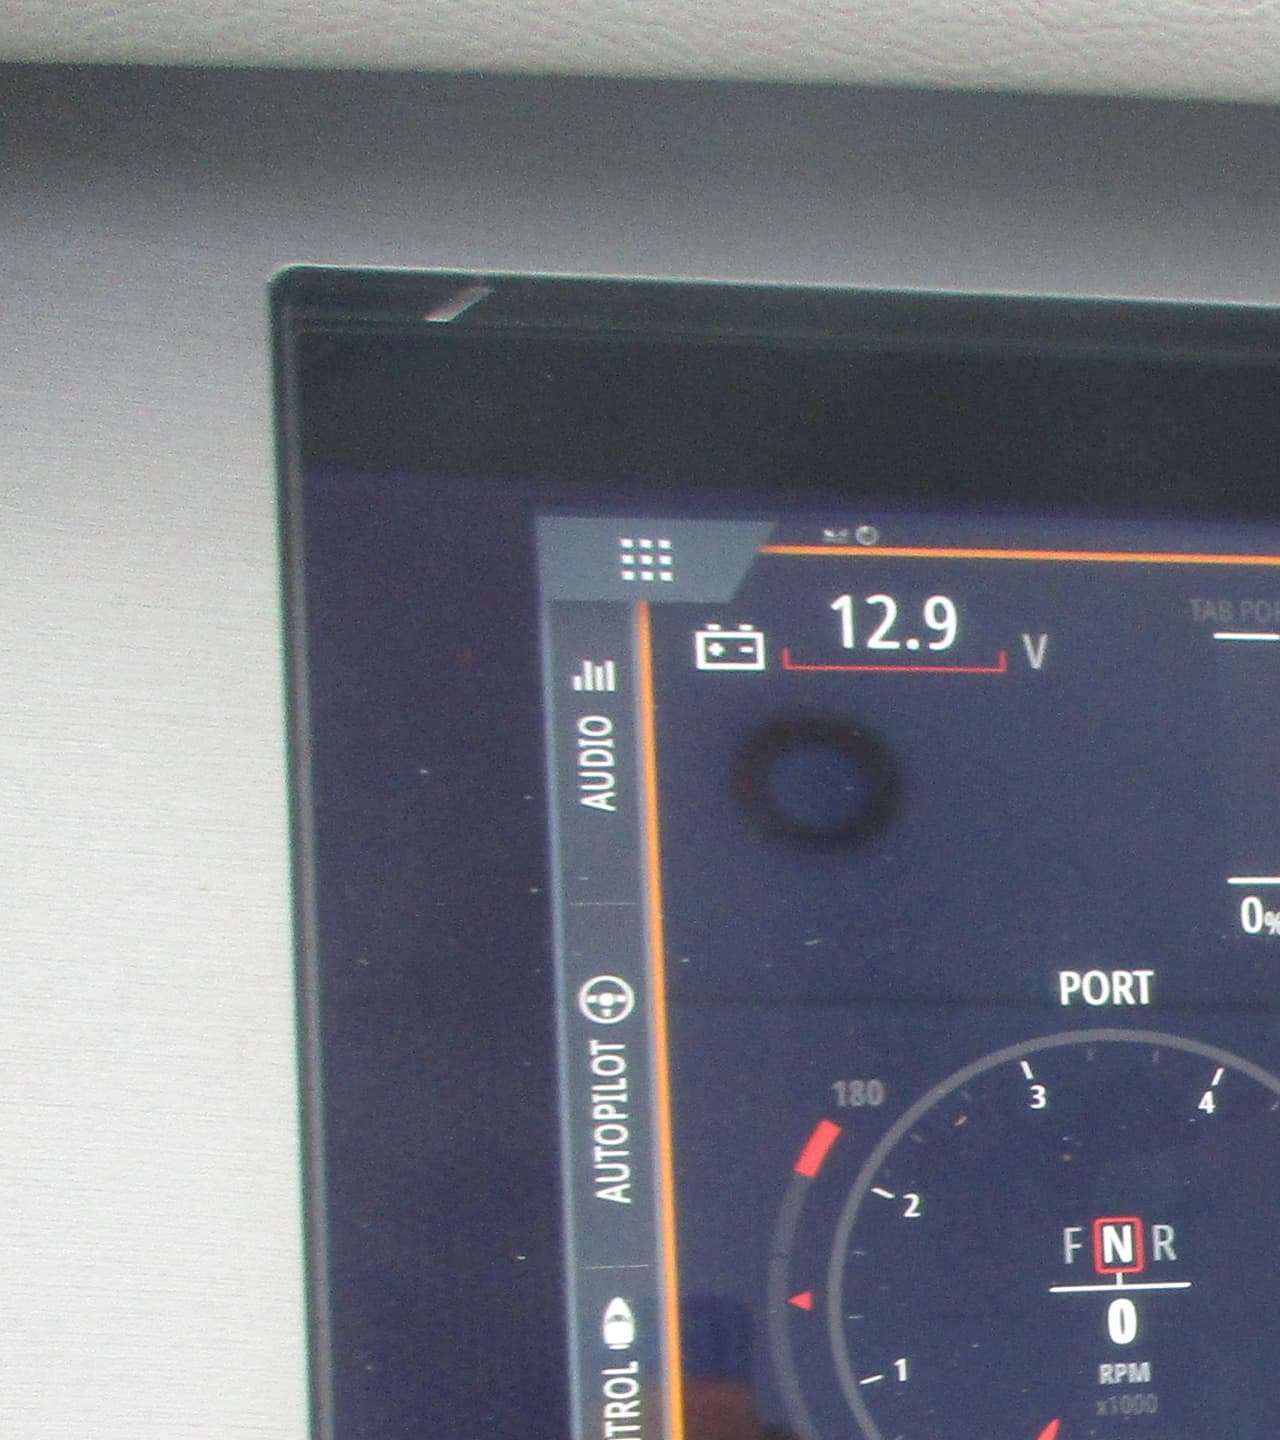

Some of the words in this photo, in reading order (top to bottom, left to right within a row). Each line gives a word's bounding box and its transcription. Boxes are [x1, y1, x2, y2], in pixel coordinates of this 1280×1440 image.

[830, 595, 958, 650] 12.9
[1022, 633, 1048, 669] V
[578, 715, 616, 811] AUDIO
[1058, 969, 1154, 1006] PORT
[832, 1079, 885, 1107] 180
[1029, 1085, 1047, 1110] 3
[1198, 1090, 1216, 1115] 4
[590, 1039, 632, 1204] AUTOPILOT
[904, 1194, 921, 1218] 2
[1064, 1227, 1083, 1264] F
[1104, 1224, 1134, 1263] N
[1154, 1225, 1177, 1261] R
[1107, 1298, 1138, 1345] 0
[893, 1358, 908, 1382] 1
[1099, 1362, 1151, 1385] RPM
